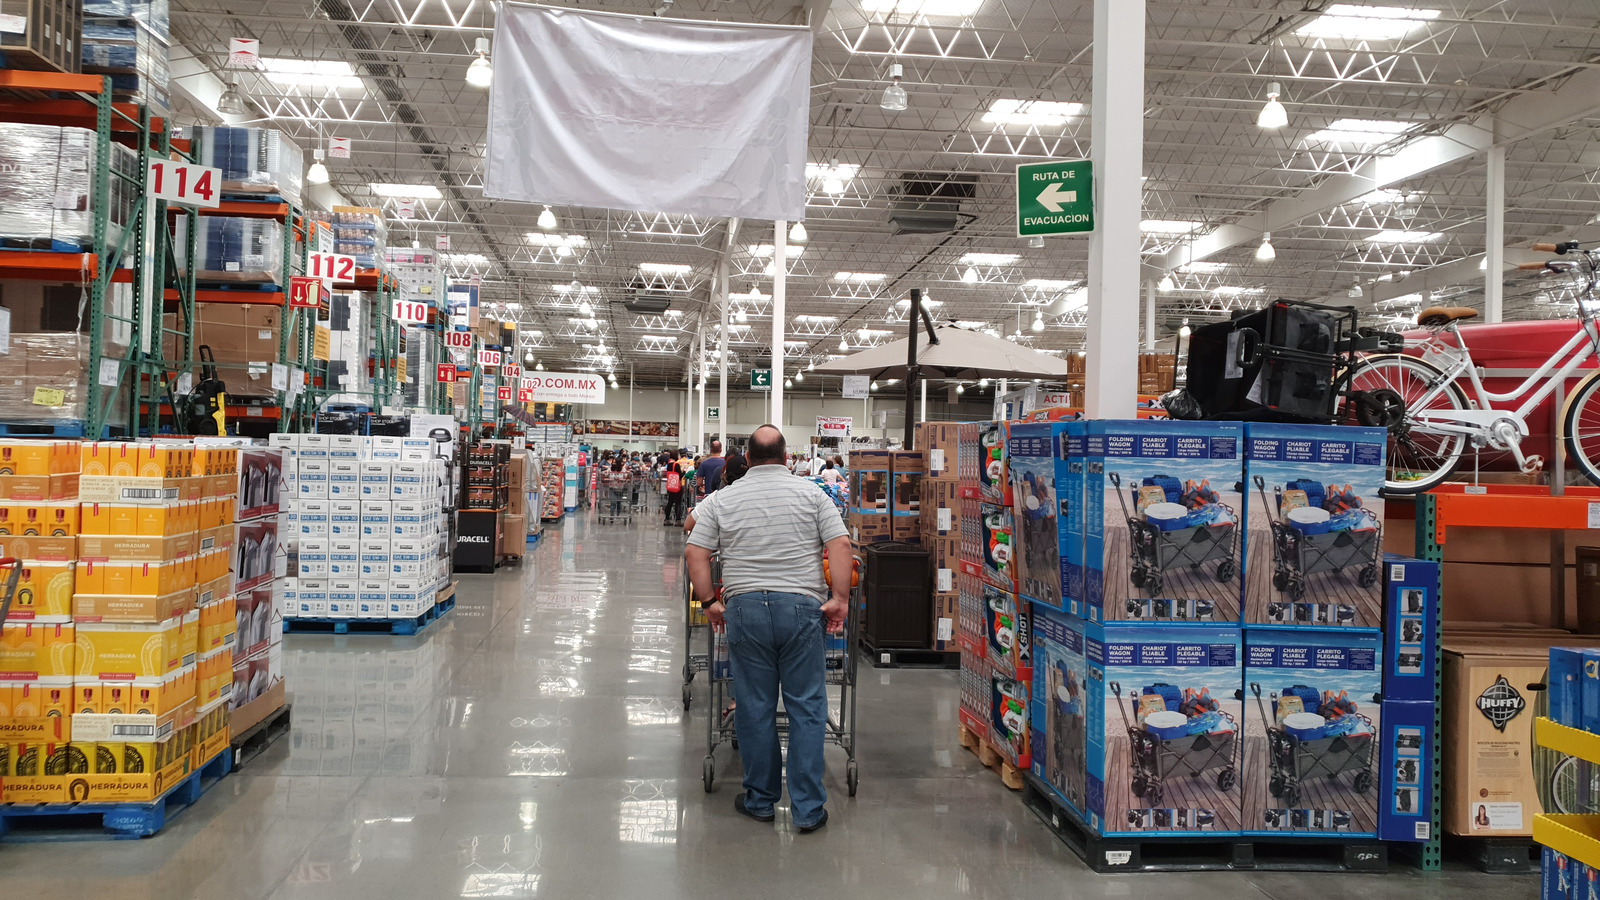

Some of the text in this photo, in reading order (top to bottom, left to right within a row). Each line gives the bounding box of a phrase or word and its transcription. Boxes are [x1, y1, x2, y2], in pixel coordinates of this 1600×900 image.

[151, 163, 213, 200] 114
[1033, 170, 1075, 181] RUTA DE
[1024, 214, 1089, 226] EVACUACION
[311, 254, 353, 281] 112
[396, 302, 425, 321] 110
[446, 331, 471, 347] 108
[479, 351, 500, 364] 106
[503, 366, 520, 377] 104
[523, 380, 537, 389] 102
[1044, 395, 1070, 404] ACTI
[1481, 696, 1520, 710] HUFFY
[91, 782, 148, 790] HERRADURA
